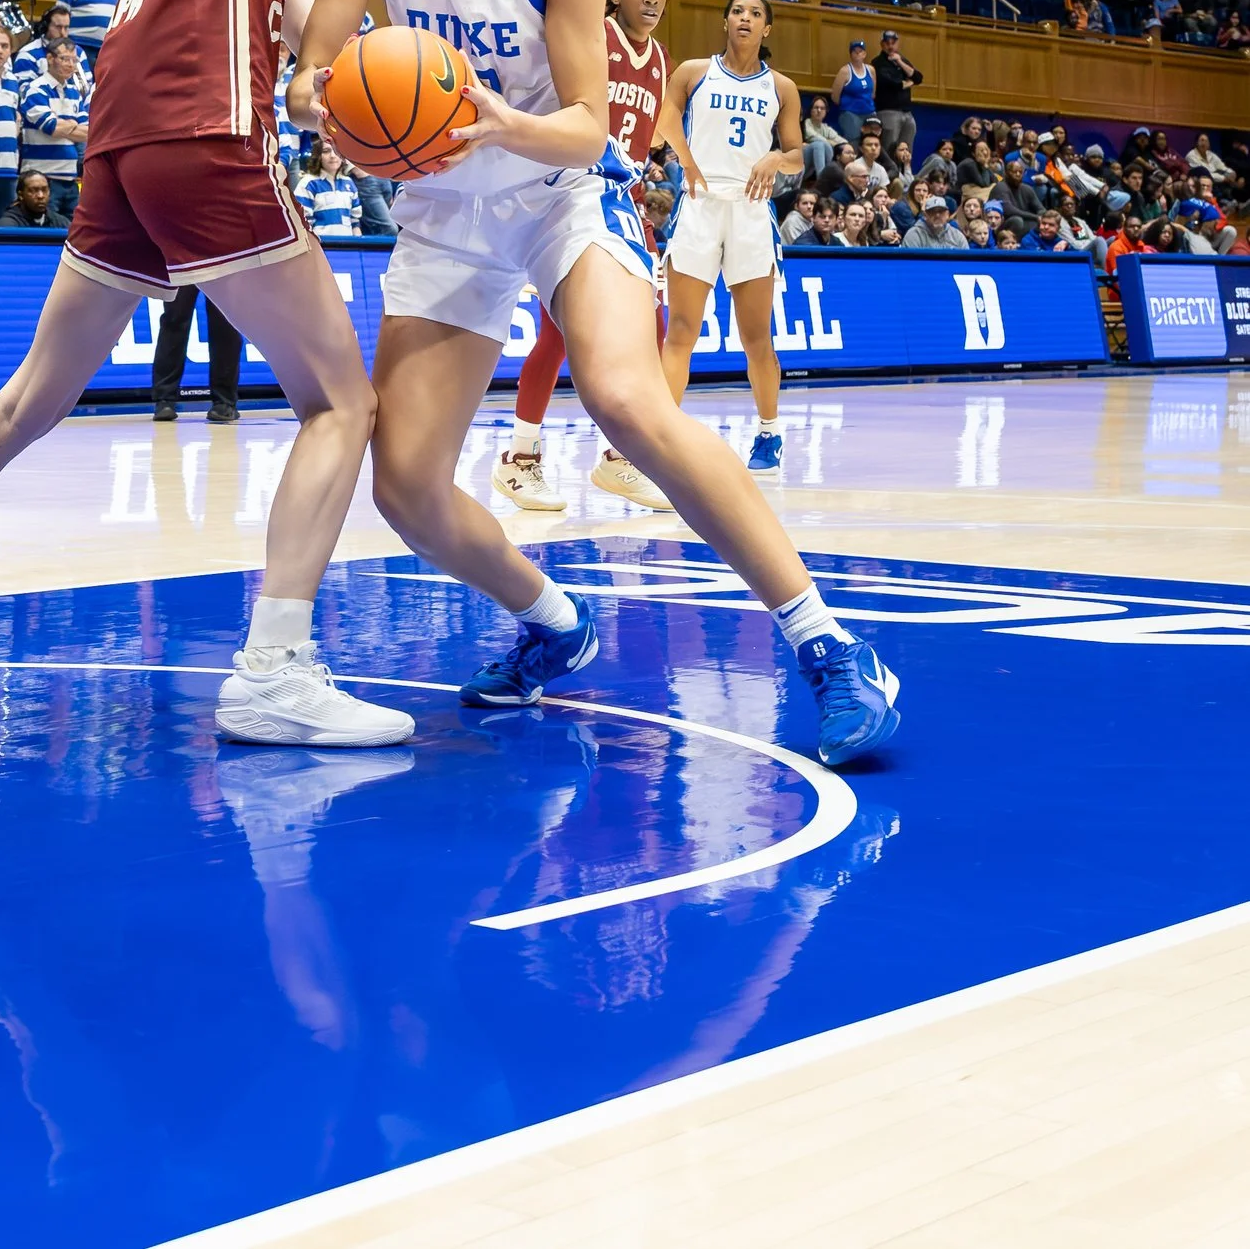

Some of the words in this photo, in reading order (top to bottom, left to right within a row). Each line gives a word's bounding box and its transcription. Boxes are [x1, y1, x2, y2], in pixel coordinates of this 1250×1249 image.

[406, 9, 521, 58] DUKE
[607, 81, 657, 122] BOSTON
[710, 93, 768, 117] DUKE
[618, 111, 637, 152] 2
[728, 117, 746, 147] 3
[1150, 297, 1215, 325] DIRECTV
